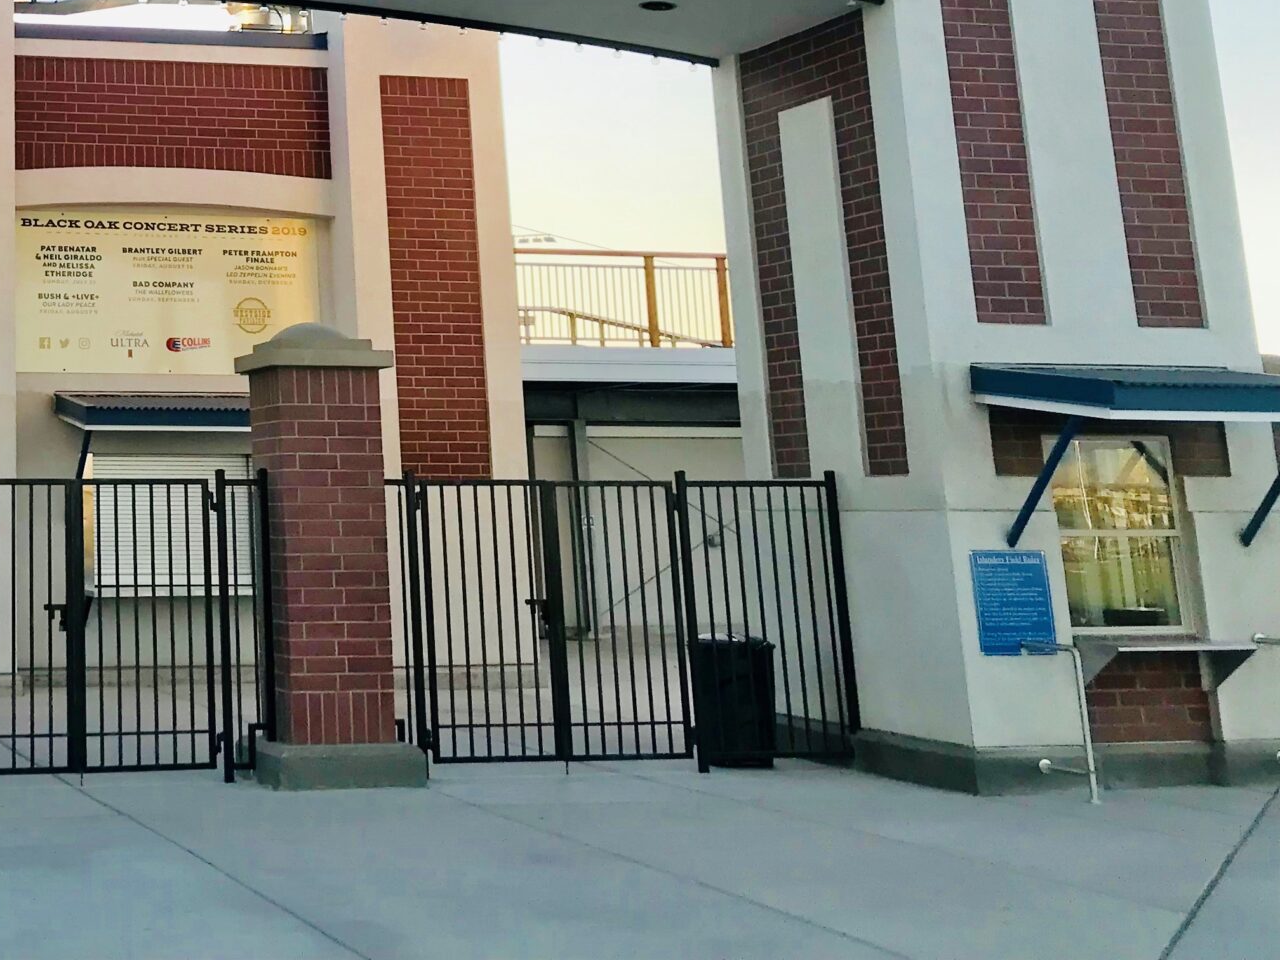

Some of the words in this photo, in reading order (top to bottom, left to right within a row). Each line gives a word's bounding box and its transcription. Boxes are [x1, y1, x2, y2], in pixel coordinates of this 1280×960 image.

[21, 218, 80, 228] BLACK
[84, 220, 120, 230] OAK
[123, 222, 201, 232] CONCERT
[205, 224, 269, 235] SERIES
[272, 226, 307, 236] 2019
[111, 338, 150, 348] ULTRA
[182, 338, 211, 347] COLLINS
